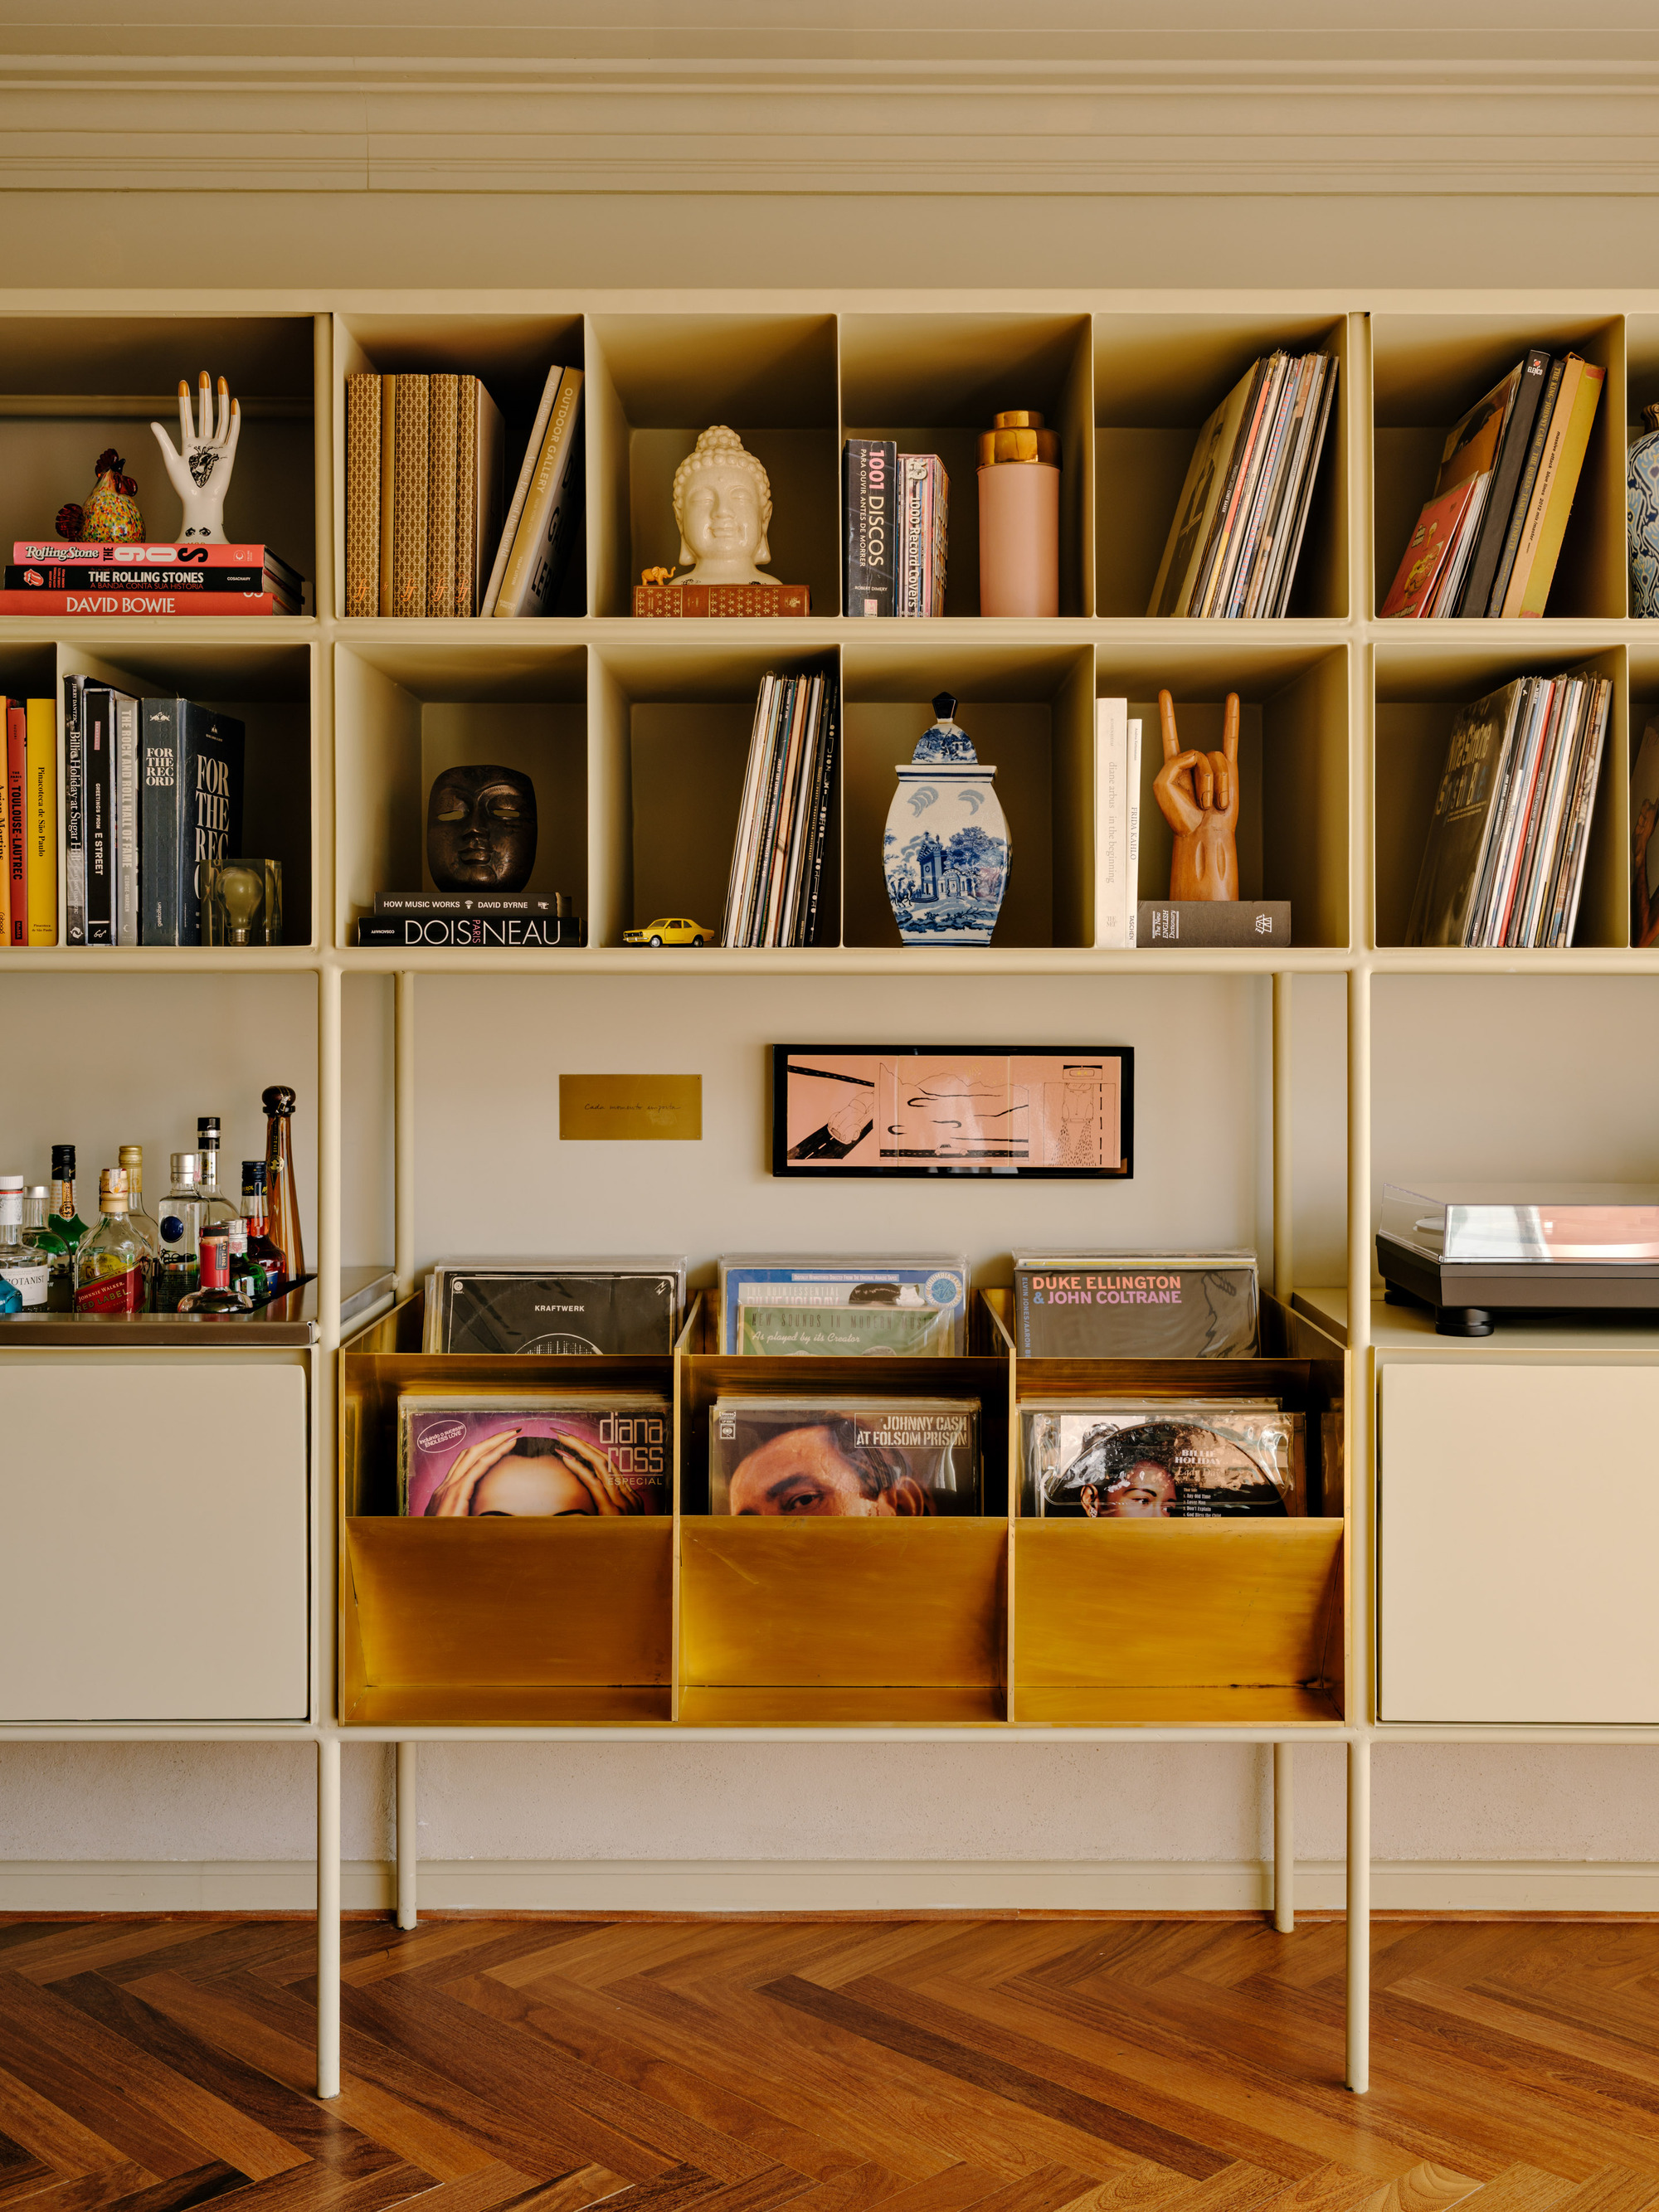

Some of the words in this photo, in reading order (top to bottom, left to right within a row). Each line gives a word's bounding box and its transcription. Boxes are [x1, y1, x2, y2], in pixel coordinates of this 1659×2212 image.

[1552, 367, 1560, 381] THE
[552, 387, 572, 442] OUTDOOR
[1535, 426, 1545, 445] CASH
[1530, 452, 1539, 465] THE
[537, 445, 556, 493] GALLERY
[869, 450, 884, 489] 1001
[514, 480, 527, 503] Edge
[910, 497, 921, 524] 1000
[508, 515, 517, 529] the
[860, 523, 866, 532] DE
[868, 496, 884, 566] DISCOS
[1509, 518, 1521, 550] WYNETTE
[500, 531, 513, 557] World
[909, 527, 921, 566] Record
[103, 547, 113, 561] THE
[89, 571, 109, 582] THE
[113, 571, 160, 582] ROLLING
[163, 572, 204, 583] STONES
[908, 568, 920, 607] Covers
[66, 597, 118, 613] DAVID
[122, 597, 176, 613] BOWIE
[122, 710, 131, 727] THE
[122, 730, 132, 758] ROCK
[146, 748, 173, 757] FOR
[122, 760, 132, 778] AND
[146, 757, 173, 766] THE
[68, 760, 80, 795] Holiday
[146, 767, 173, 776] REC
[146, 776, 173, 785] ORD
[197, 754, 230, 797] FOR
[1109, 761, 1117, 784] diane
[122, 780, 132, 803] ROLL
[1108, 785, 1117, 808] arbus
[122, 806, 132, 827] HALL
[196, 790, 229, 831] THE
[1109, 816, 1117, 824] in
[12, 786, 22, 880] TOULOUSE-LAUTREC
[68, 812, 80, 840] Sugar
[122, 829, 132, 841] OF
[71, 843, 80, 861] Hill
[195, 828, 229, 862] REC
[122, 843, 132, 868] FAME
[1106, 843, 1117, 883] beginning
[472, 920, 481, 943] PARIS
[747, 1286, 760, 1296] THE
[767, 1287, 839, 1296] QUINTESSENTIAL
[1033, 1276, 1081, 1289] DUKE
[1087, 1276, 1181, 1289] ELLINGTON
[76, 1300, 95, 1312] RED
[78, 1290, 100, 1303] JOHNNIE
[1034, 1292, 1044, 1304] &
[1048, 1291, 1092, 1304] JOHN
[1096, 1291, 1182, 1304] COLTRANE
[752, 1313, 771, 1326] NEW
[781, 1314, 820, 1327] SOUNDS
[831, 1315, 840, 1327] IN
[851, 1315, 891, 1329] MODERN
[752, 1331, 764, 1340] As
[767, 1331, 797, 1344] played
[800, 1332, 810, 1344] by
[813, 1332, 825, 1342] its
[827, 1332, 860, 1343] Creator
[600, 1412, 663, 1443] diana
[883, 1416, 933, 1431] JOHNNY
[937, 1417, 967, 1431] CASH
[419, 1433, 440, 1444] Incluindo
[445, 1425, 465, 1435] sucesso
[425, 1435, 448, 1448] ENDLESS
[448, 1431, 461, 1439] LOVE
[856, 1431, 871, 1445] AT
[873, 1432, 921, 1446] FOLSOM
[924, 1432, 966, 1446] PRISON
[608, 1447, 664, 1472] ross
